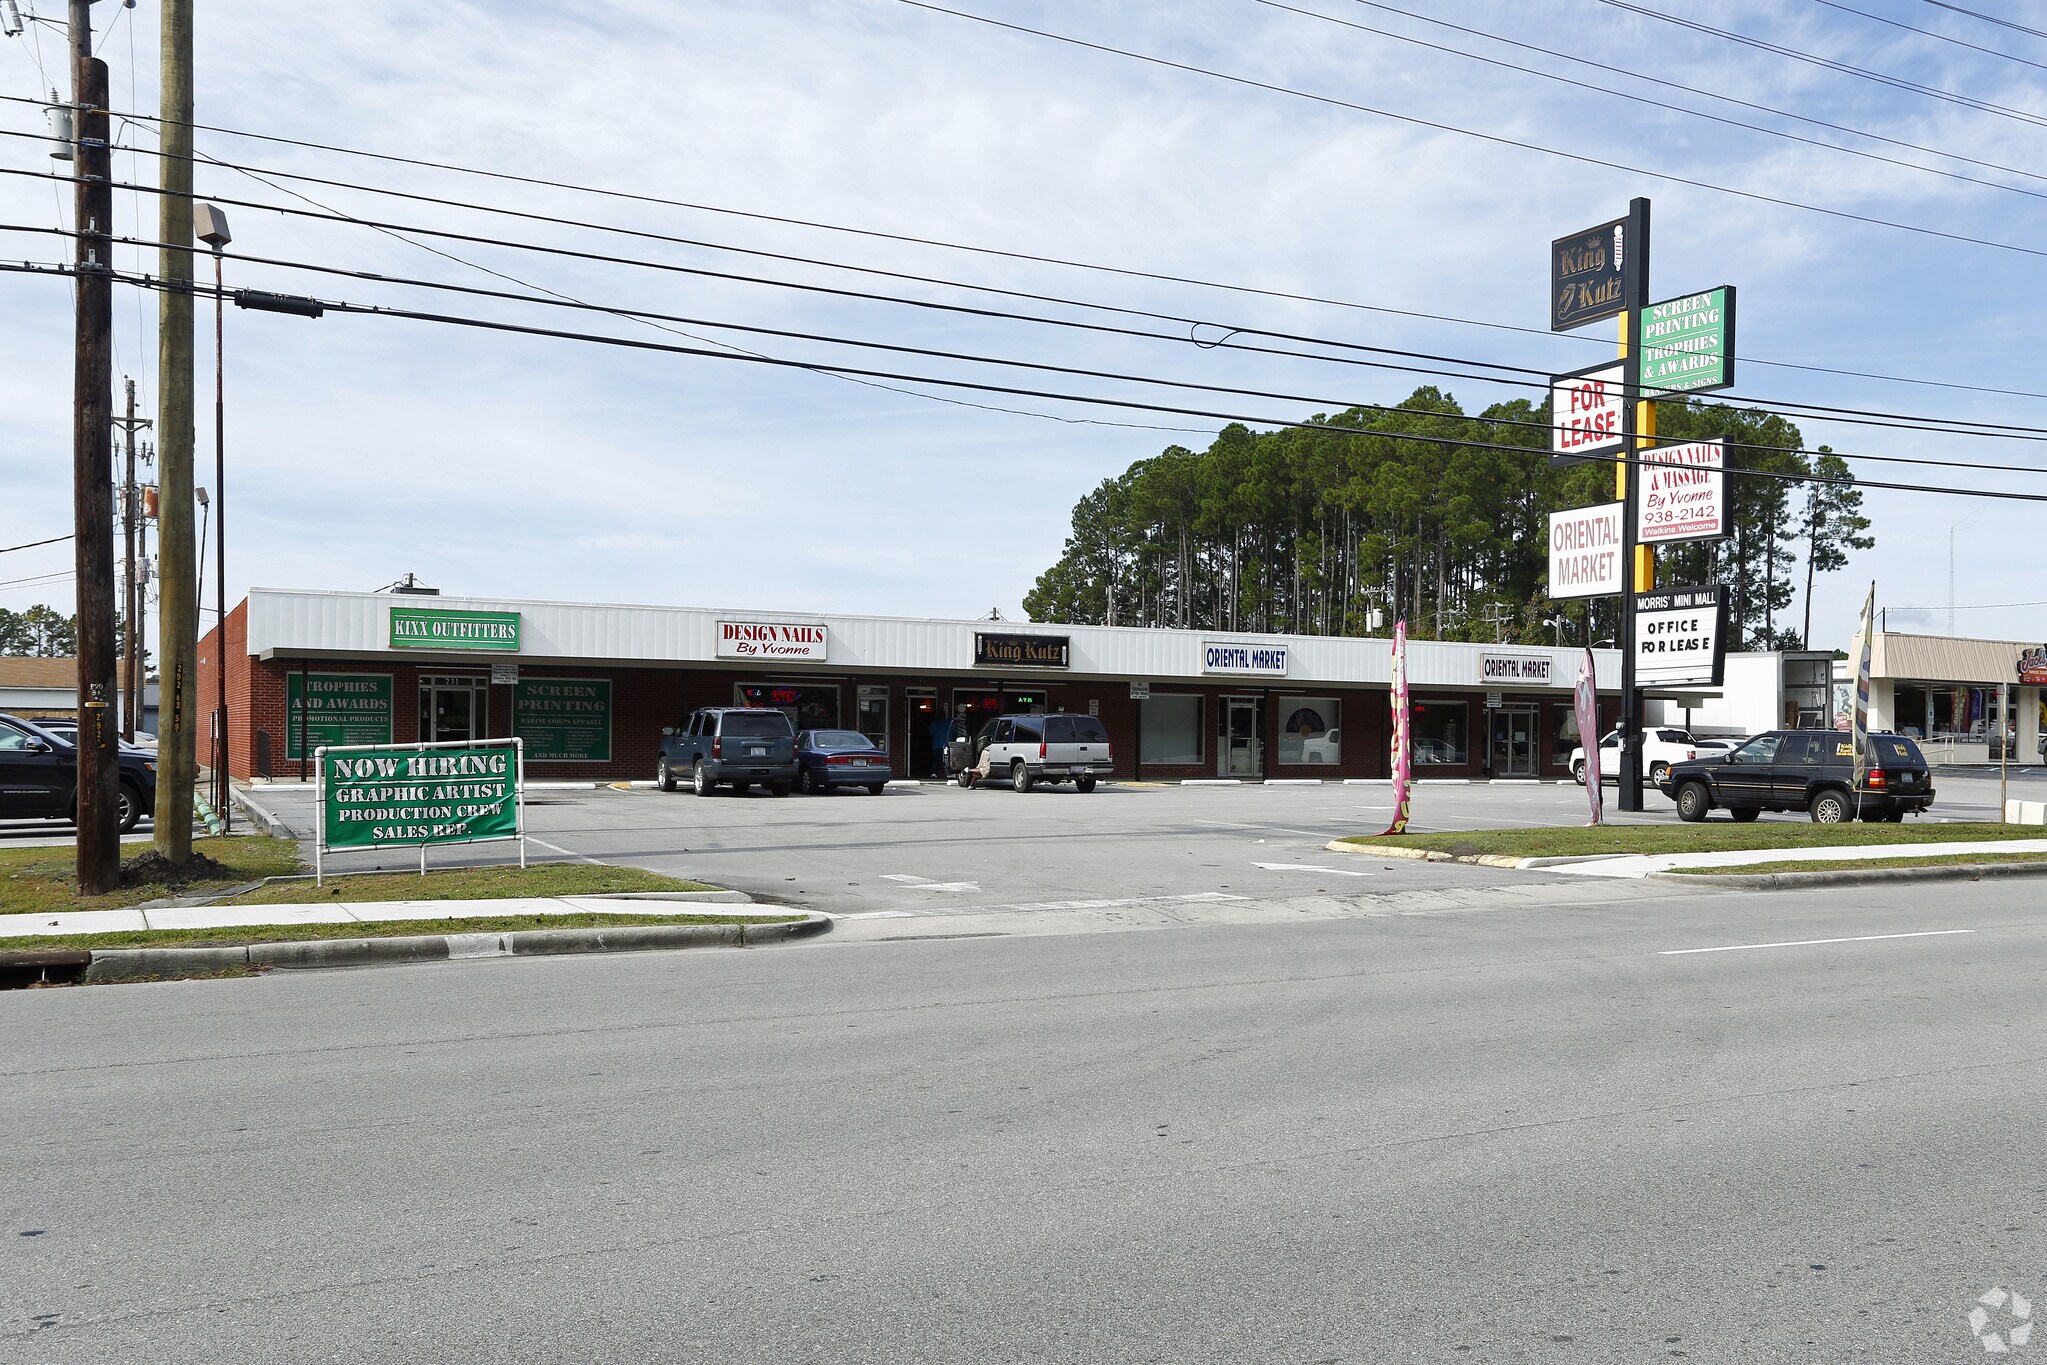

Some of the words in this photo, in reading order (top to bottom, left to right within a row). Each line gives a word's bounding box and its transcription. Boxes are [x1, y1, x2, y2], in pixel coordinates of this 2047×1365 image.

[1561, 246, 1606, 275] King
[1579, 277, 1622, 308] Kutz
[1653, 293, 1712, 320] SCREEN
[1645, 308, 1719, 339] PRINTING
[1645, 333, 1718, 362] TROPHIES
[1644, 366, 1654, 378] &
[1657, 351, 1718, 376] AWARDS
[1692, 376, 1718, 388] SIGNS
[1571, 381, 1605, 414] FOR
[1561, 411, 1615, 448] LEASE
[1687, 444, 1720, 465] NAILS
[1651, 475, 1659, 491] &
[1662, 467, 1711, 489] MASSAGE
[1647, 493, 1665, 509] By
[1670, 489, 1714, 505] Yvonne
[1644, 505, 1715, 524] 938-2142
[1554, 515, 1619, 551] ORIENTAL
[1644, 524, 1676, 536] Walkins
[1678, 521, 1716, 533] Welcome
[1558, 551, 1615, 586] MARKET
[1637, 596, 1671, 610] MORRIS'
[1674, 593, 1691, 607] MINI
[1695, 592, 1716, 606] MALL
[395, 620, 428, 636] KIXX
[432, 621, 516, 639] OUTFITTERS
[723, 624, 777, 641] DESIGN
[782, 627, 823, 643] NAILS
[1647, 619, 1698, 634] OFFICE
[736, 642, 757, 655] By
[762, 643, 810, 655] Yvonne
[985, 640, 1021, 661] King
[1025, 641, 1060, 660] Kutz
[1642, 640, 1665, 653] FOR
[1670, 637, 1710, 652] LEASE
[1207, 647, 1249, 668] ORIENTAL
[1252, 650, 1285, 669] MARKET
[1484, 659, 1520, 677] ORIENTAL
[1521, 661, 1550, 678] MARKET
[307, 681, 378, 692] TROPHIES
[527, 685, 596, 697] SCREEN
[327, 699, 387, 709] AWARDS
[518, 700, 605, 711] PRINTING
[333, 758, 399, 778] NOW
[407, 754, 506, 777] HIRING
[335, 786, 429, 803] GRAPHIC
[432, 783, 506, 800] ARTIST
[338, 805, 452, 822] PRODUCTION
[456, 803, 503, 818] CREW
[373, 824, 429, 839] SALES
[432, 823, 473, 837] REP.
